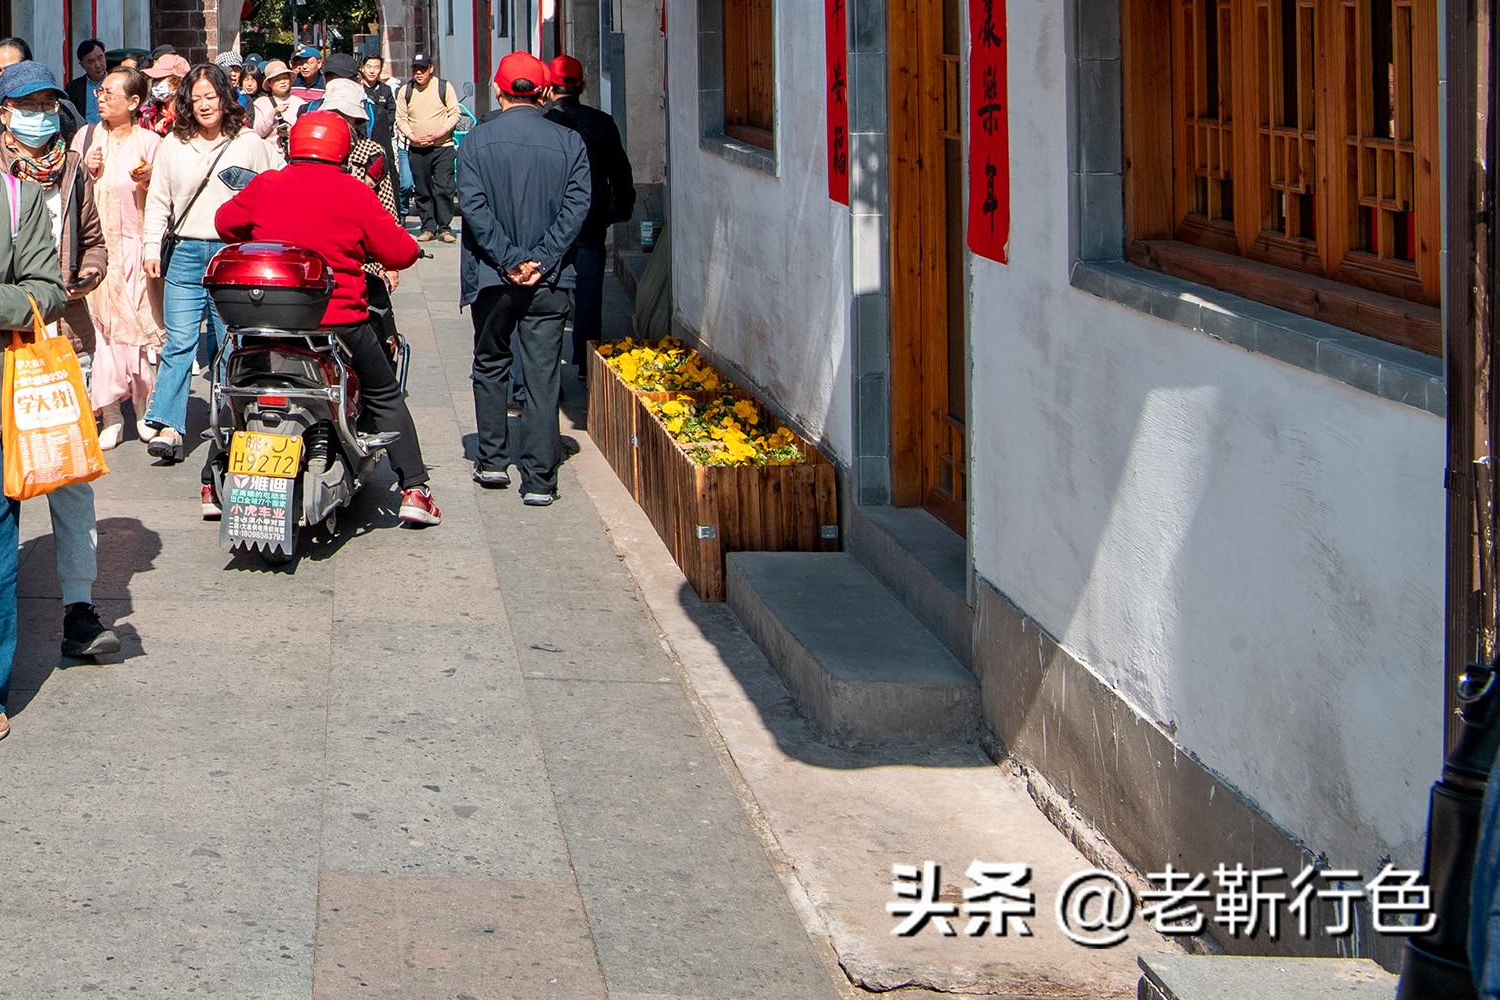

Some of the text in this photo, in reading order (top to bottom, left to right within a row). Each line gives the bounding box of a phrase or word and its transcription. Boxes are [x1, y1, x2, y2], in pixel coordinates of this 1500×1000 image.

[232, 451, 295, 475] H9272
[249, 476, 288, 493] 雅迪
[230, 495, 287, 509] 出口全球77个国家
[231, 488, 288, 501] 更高端的电动车
[229, 504, 286, 519] 小虎车业
